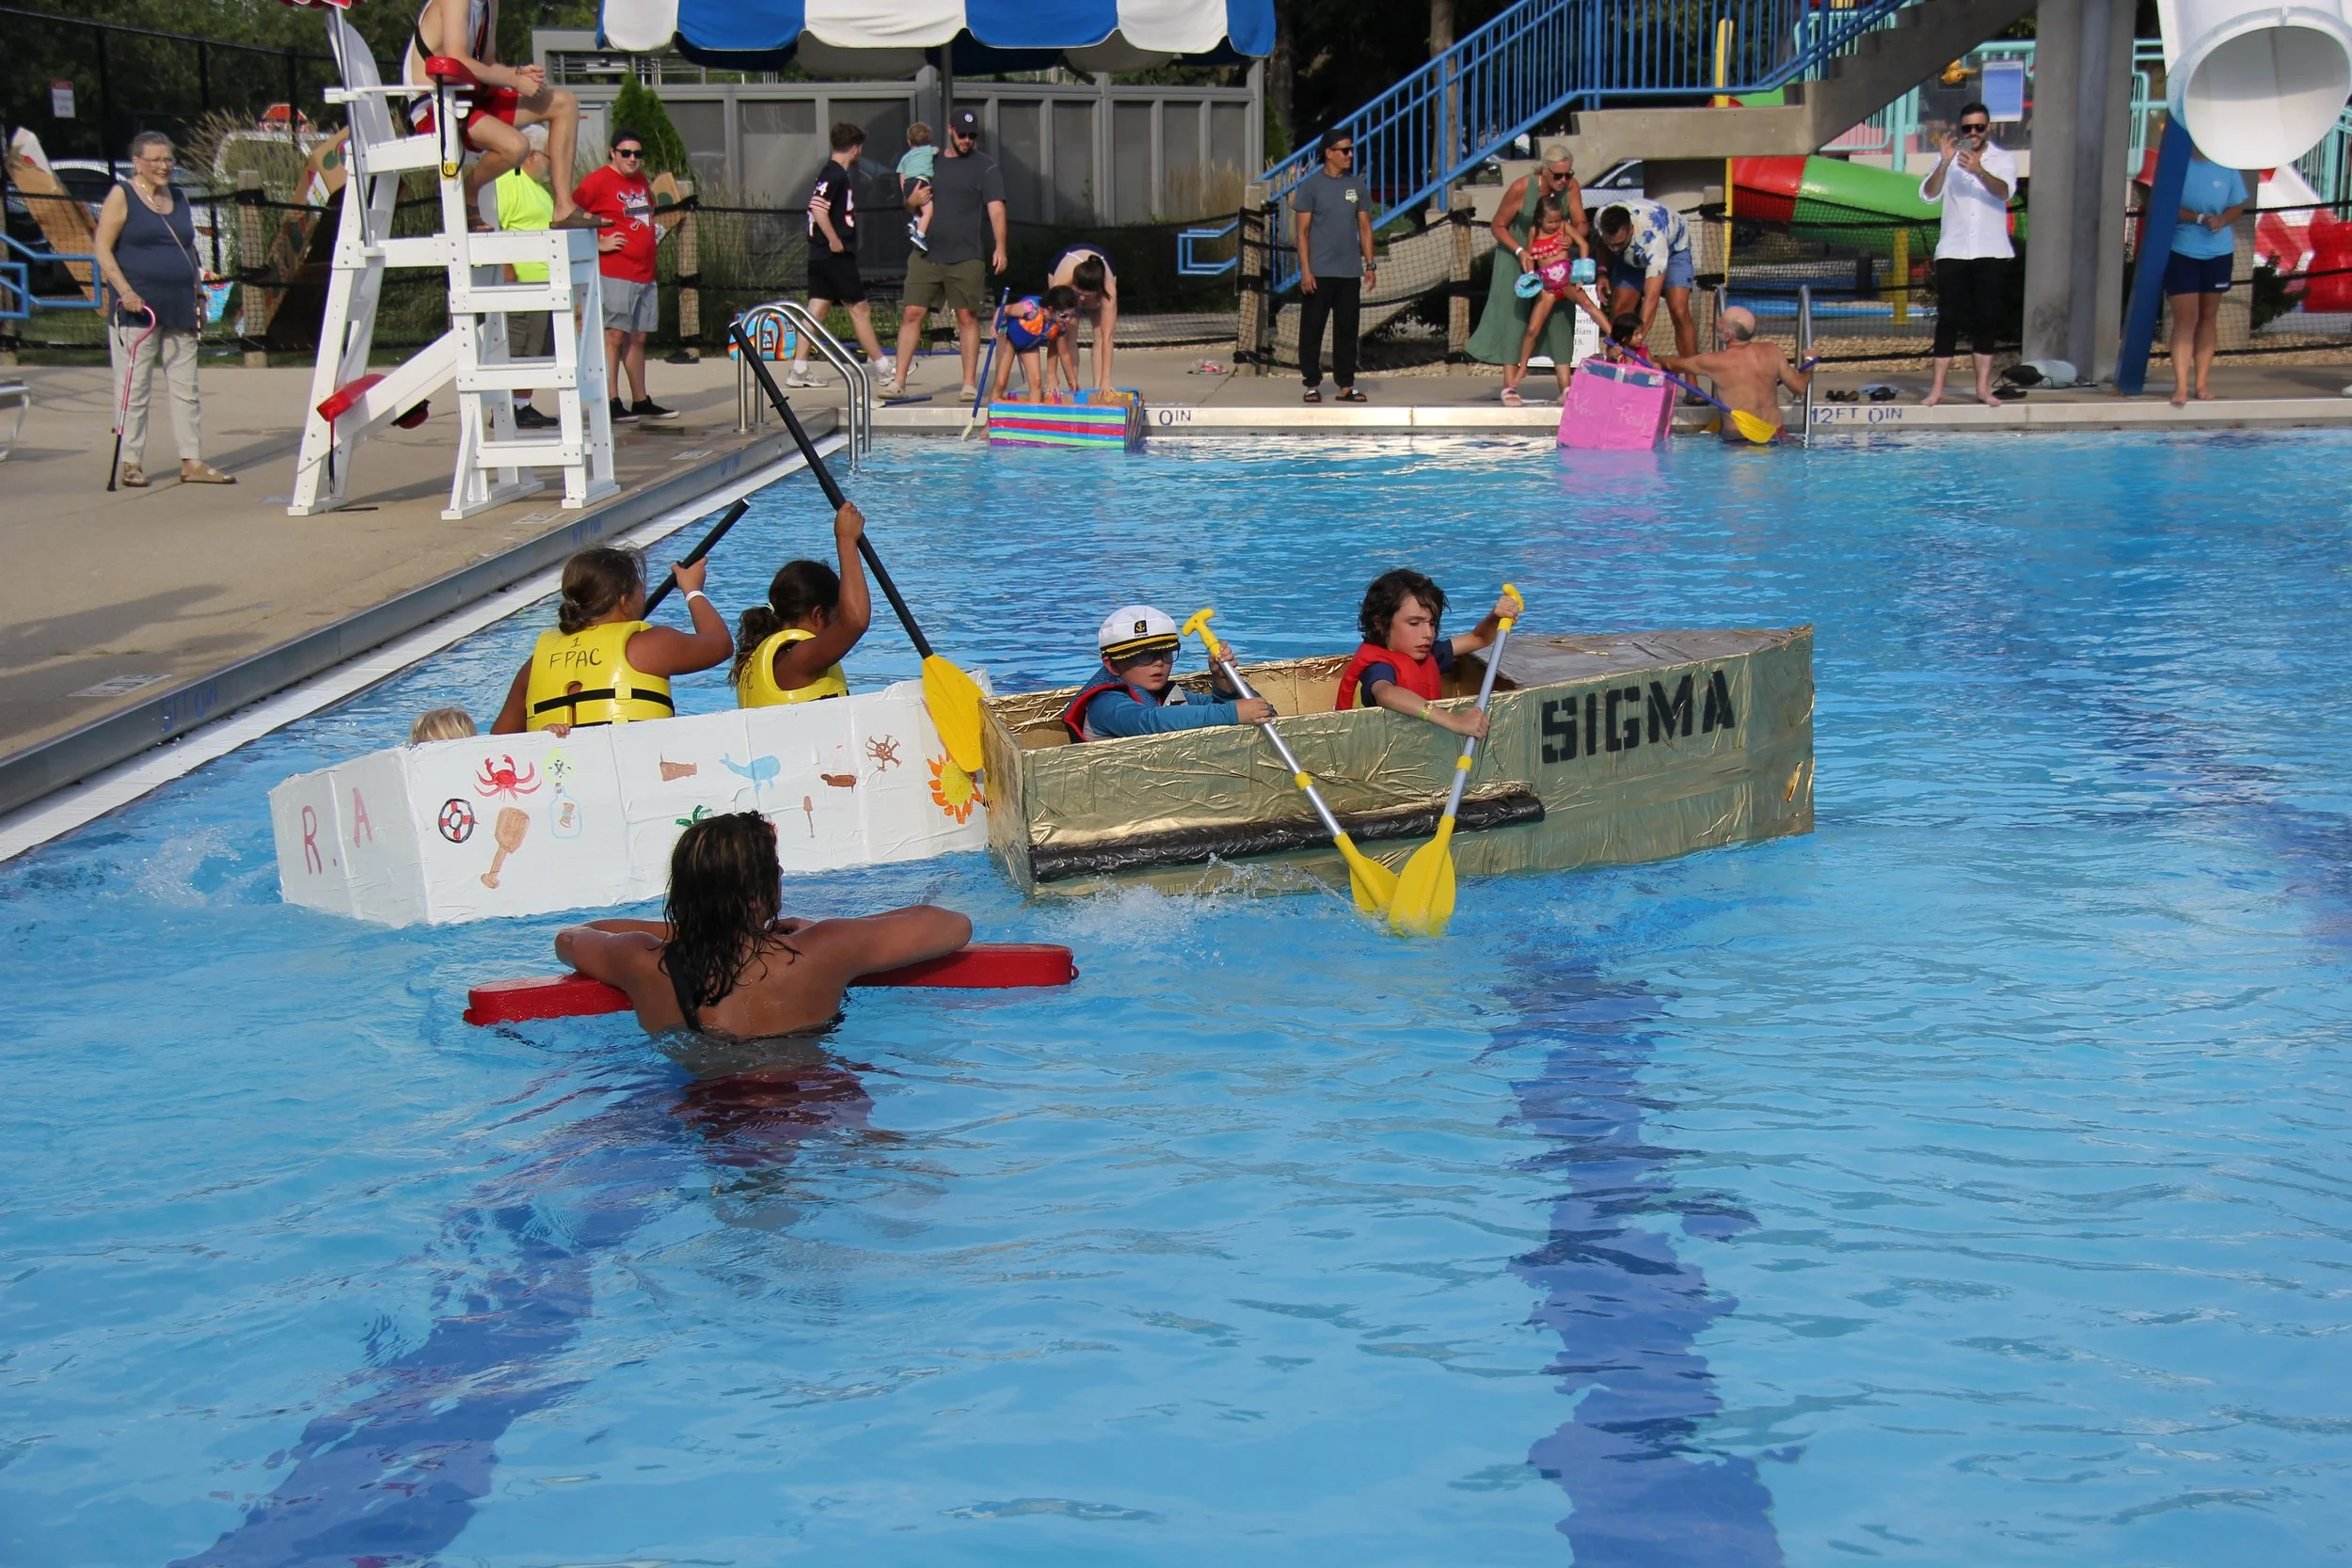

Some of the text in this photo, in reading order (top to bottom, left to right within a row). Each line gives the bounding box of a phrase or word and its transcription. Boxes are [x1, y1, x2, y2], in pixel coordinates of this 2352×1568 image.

[549, 647, 602, 670] FPAC
[1542, 670, 1736, 764] SIGMA
[352, 786, 373, 848] A
